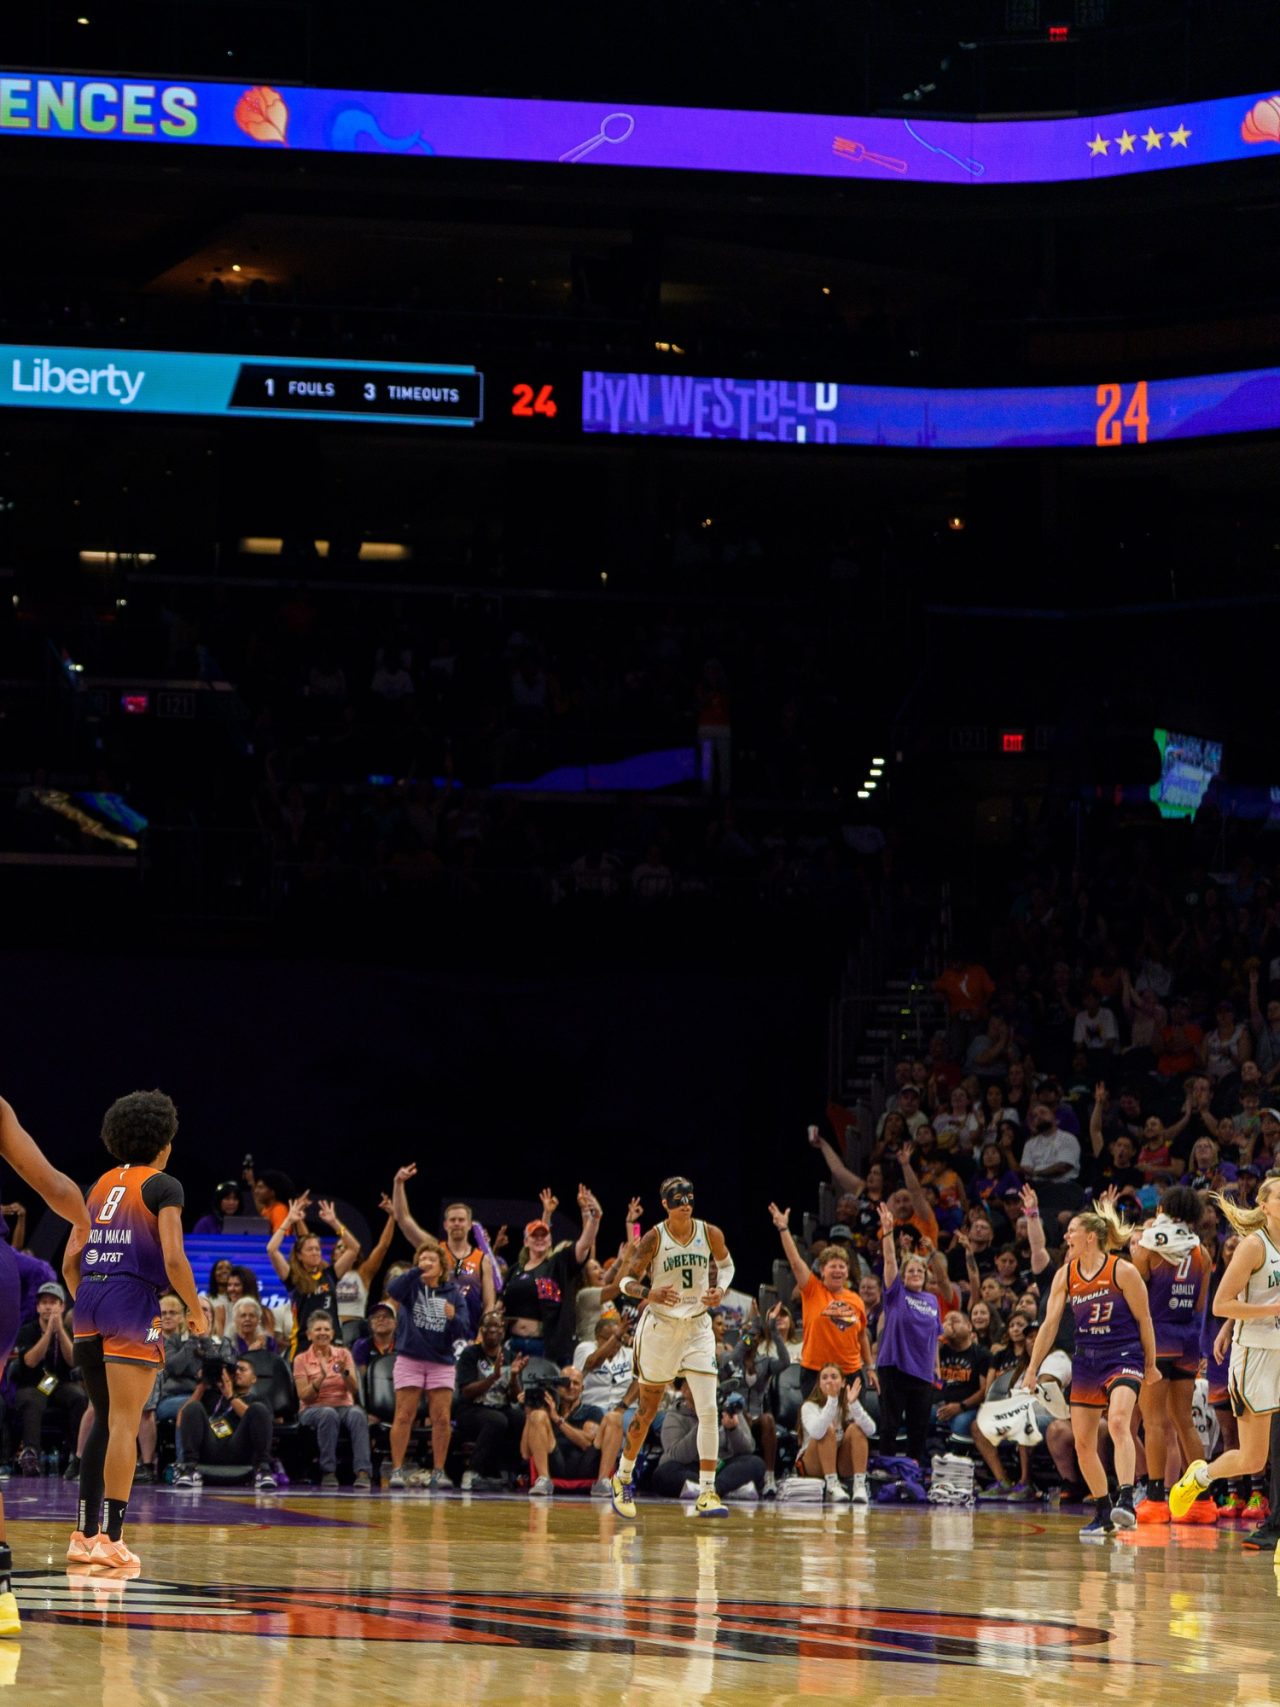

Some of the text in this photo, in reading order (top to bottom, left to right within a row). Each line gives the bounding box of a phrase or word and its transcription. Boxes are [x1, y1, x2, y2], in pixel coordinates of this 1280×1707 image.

[11, 358, 145, 405] Liberty
[265, 378, 335, 397] 1 FOULS
[364, 382, 460, 402] 3 TIMEOUTS
[511, 383, 558, 418] 24
[1096, 380, 1150, 447] 24
[95, 1185, 127, 1225] 8
[99, 1252, 124, 1263] AT&T
[663, 1253, 708, 1273] LIBERTY
[681, 1268, 693, 1290] 9
[1072, 1288, 1110, 1306] Phoenix
[1087, 1301, 1114, 1323] 33
